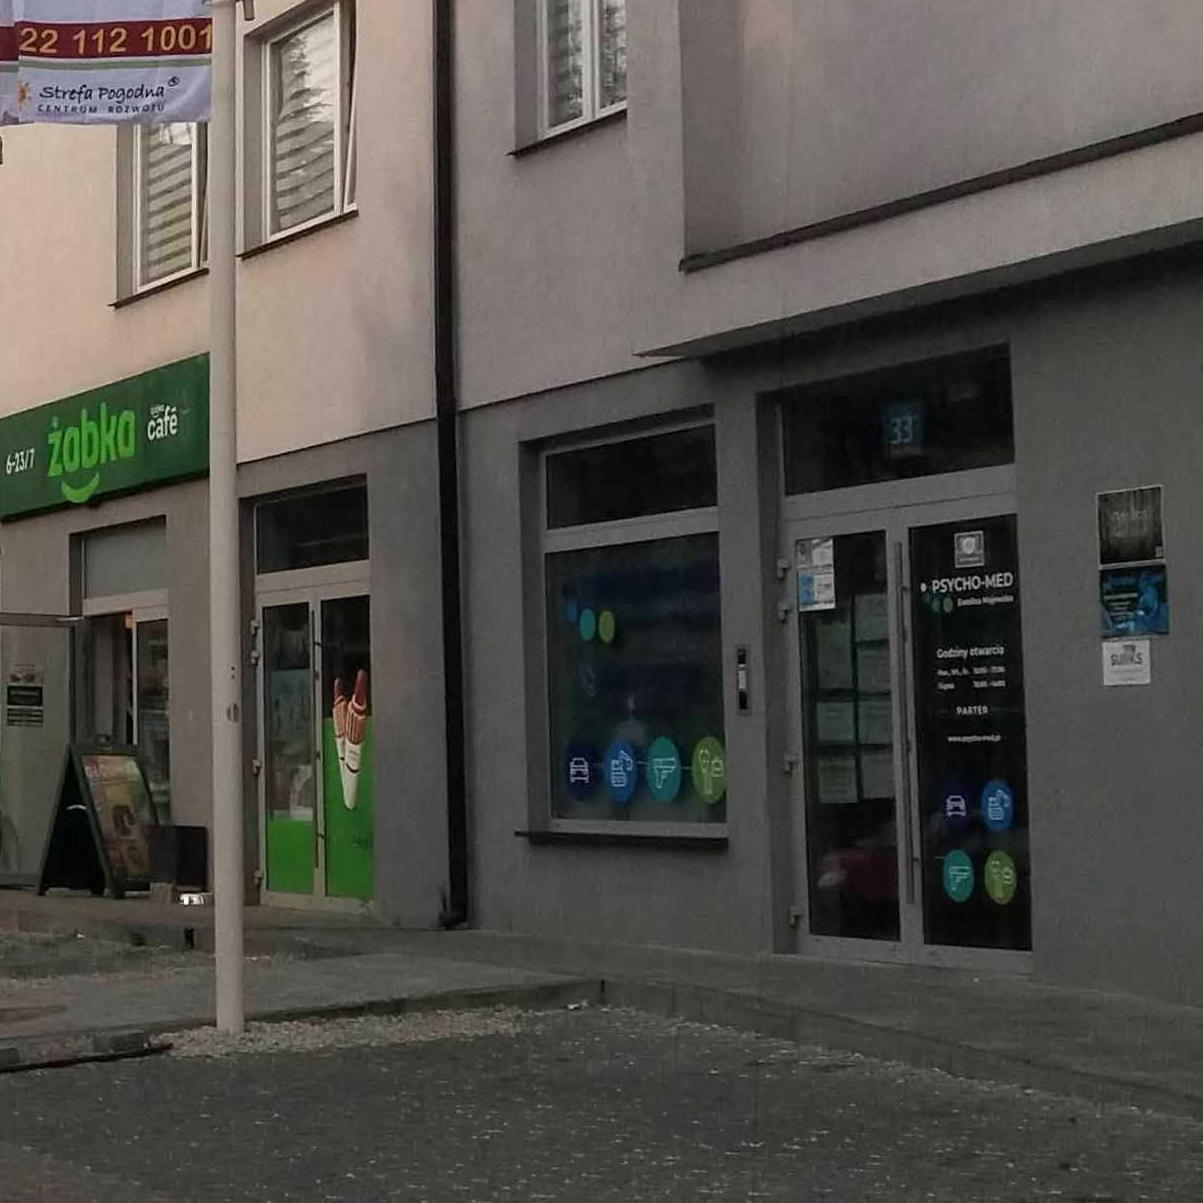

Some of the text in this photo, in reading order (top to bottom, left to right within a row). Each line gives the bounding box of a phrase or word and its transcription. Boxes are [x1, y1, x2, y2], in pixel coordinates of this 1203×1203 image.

[19, 24, 212, 54] 22 112 1001
[39, 84, 165, 104] Strefa Pogodna
[37, 104, 98, 114] CENTRUM
[147, 405, 178, 441] café
[47, 403, 136, 477] żabka
[6, 448, 35, 475] 6-23/7
[931, 572, 1014, 594] PSYCHO-MED
